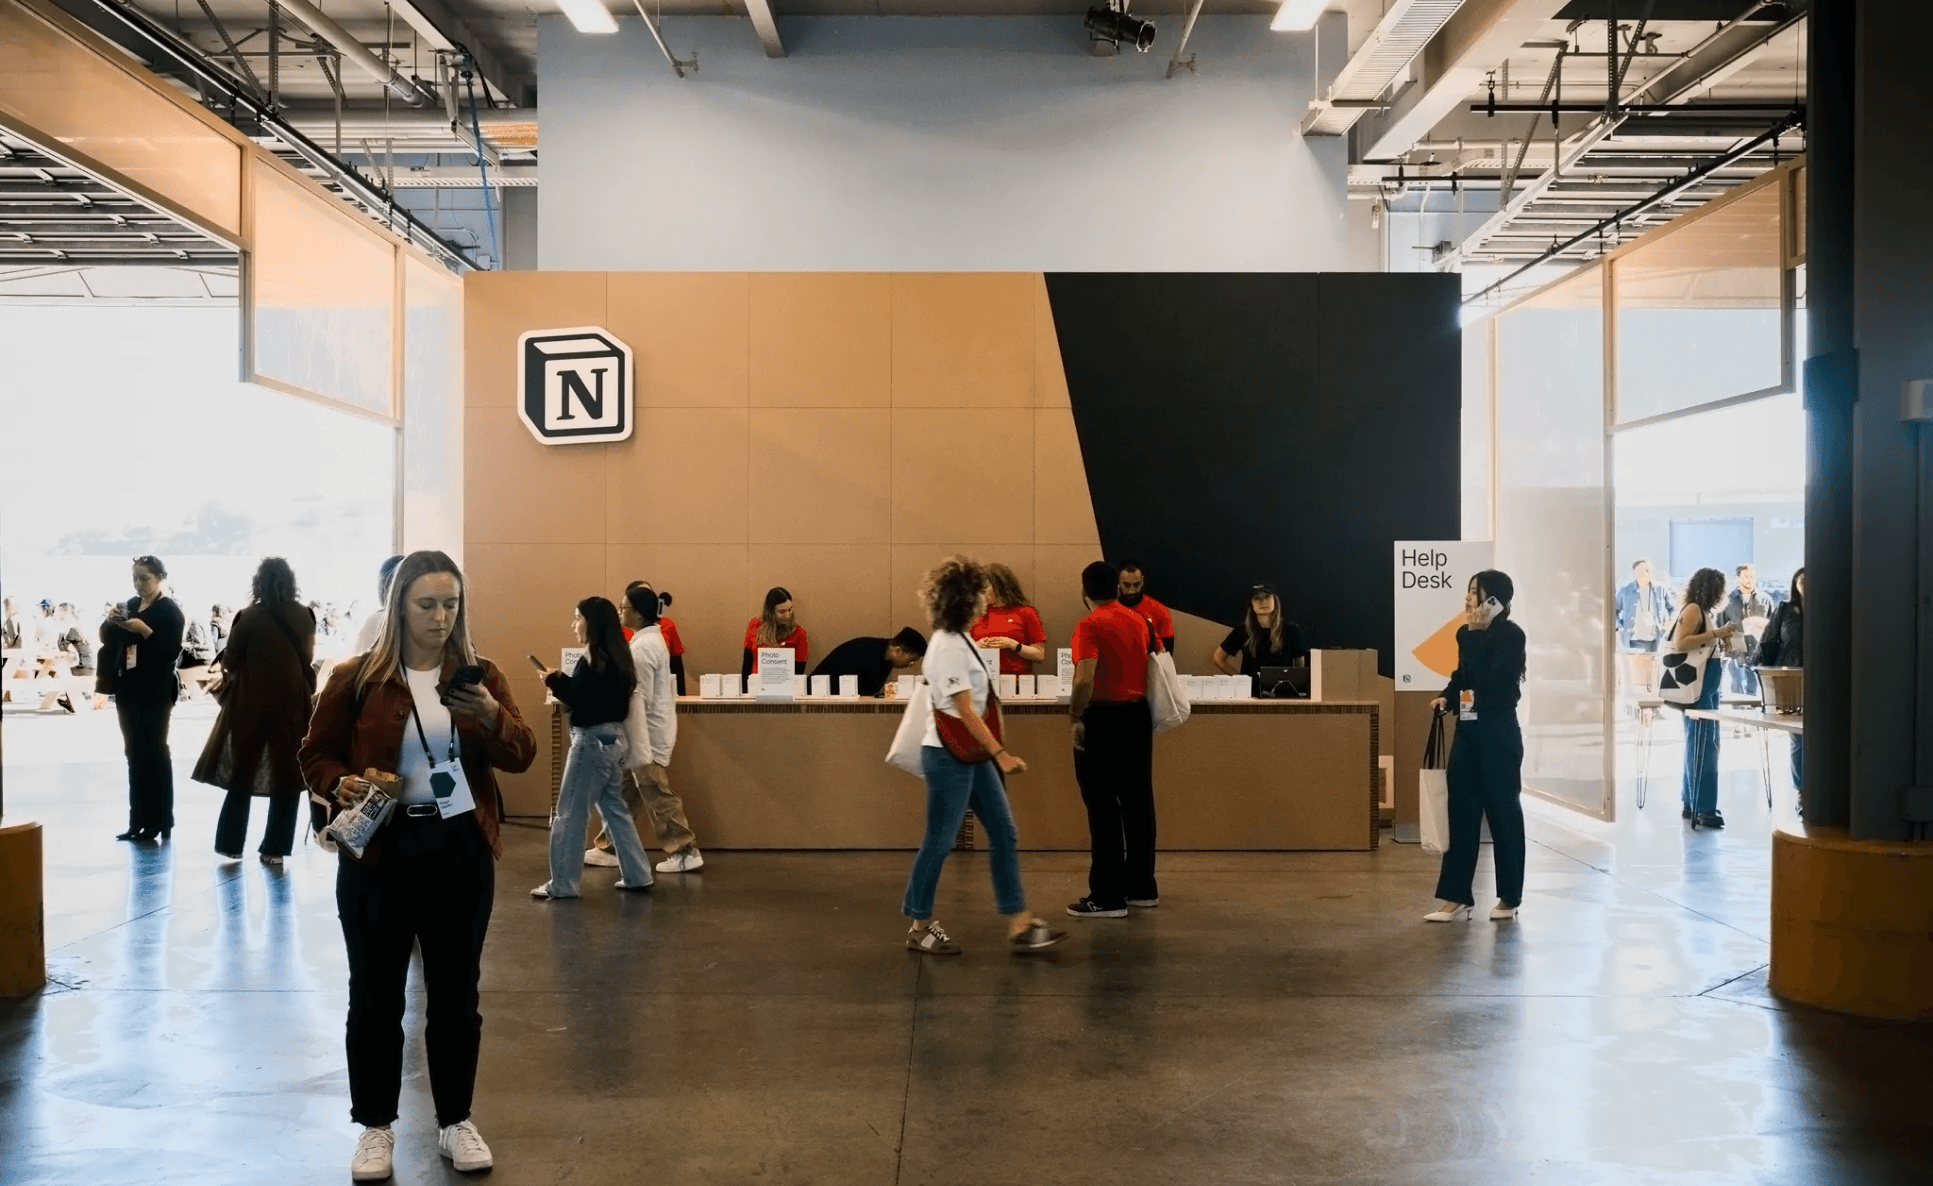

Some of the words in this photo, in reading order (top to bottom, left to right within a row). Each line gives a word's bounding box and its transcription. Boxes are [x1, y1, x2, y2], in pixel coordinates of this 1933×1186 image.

[556, 368, 608, 420] N
[1402, 549, 1448, 571] Help
[1402, 571, 1452, 588] Desk
[362, 806, 378, 821] DELI
